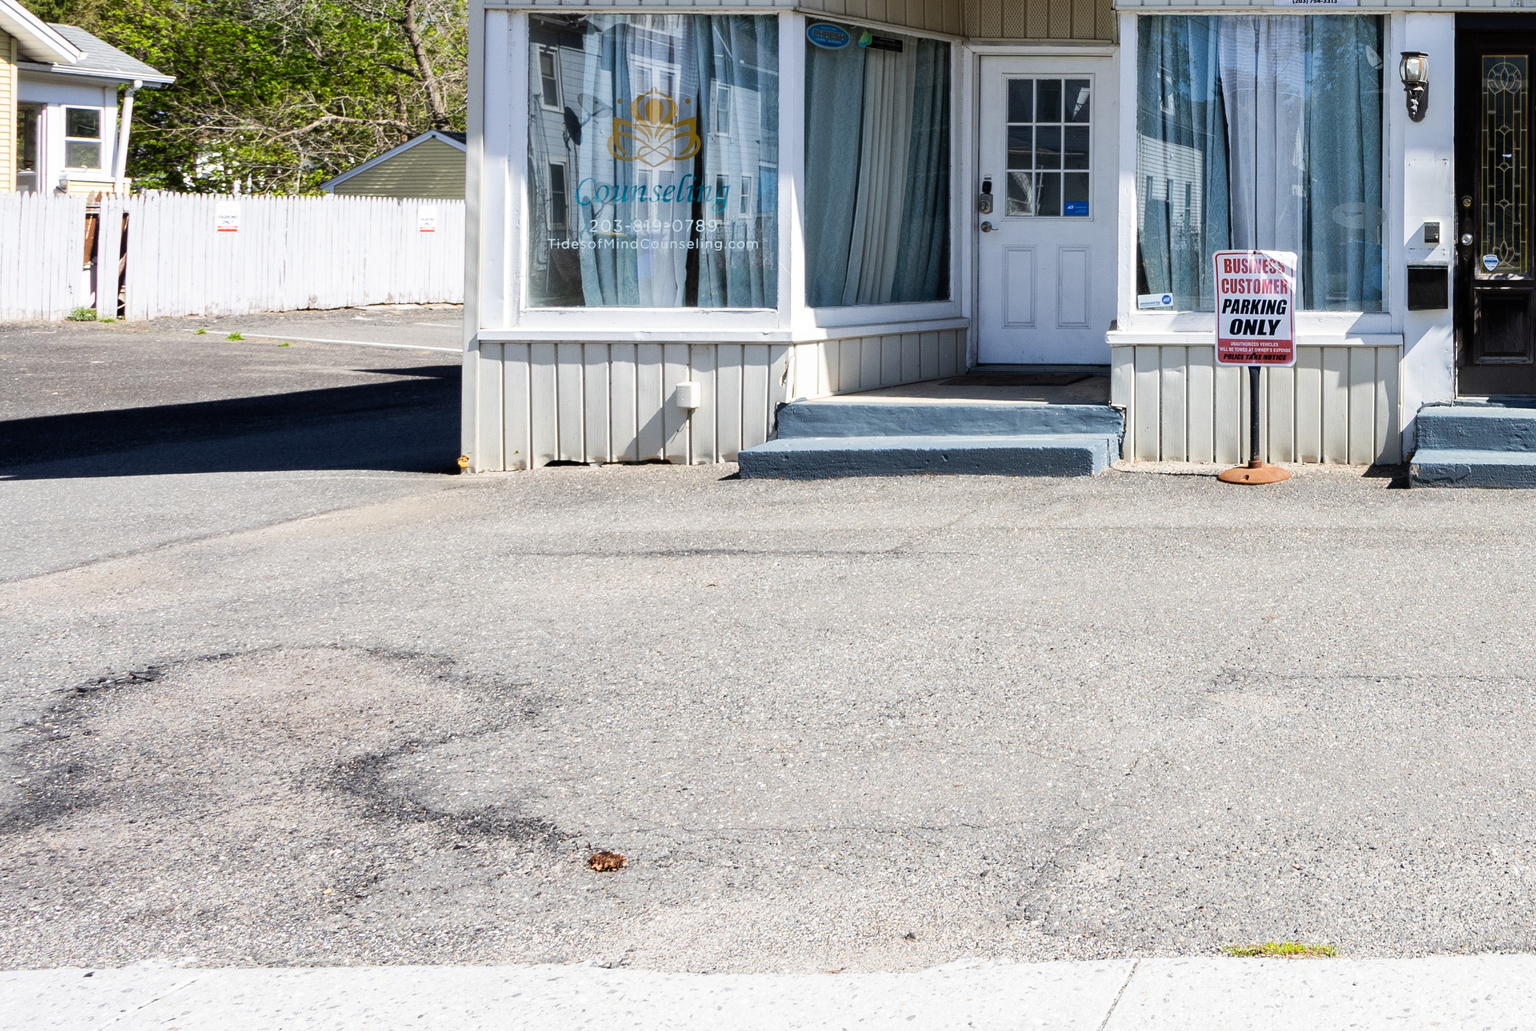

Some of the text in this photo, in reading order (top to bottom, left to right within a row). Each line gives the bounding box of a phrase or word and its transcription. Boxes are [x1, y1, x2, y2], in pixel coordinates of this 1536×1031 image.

[575, 173, 732, 213] Counseling
[589, 219, 719, 233] 203-819-0789
[548, 237, 759, 251] TidesofMindCounseling.com
[1223, 258, 1286, 274] BUSINESS
[1221, 278, 1288, 295] CUSTOMER
[1221, 298, 1288, 316] PARKING
[1229, 318, 1282, 336] ONLY
